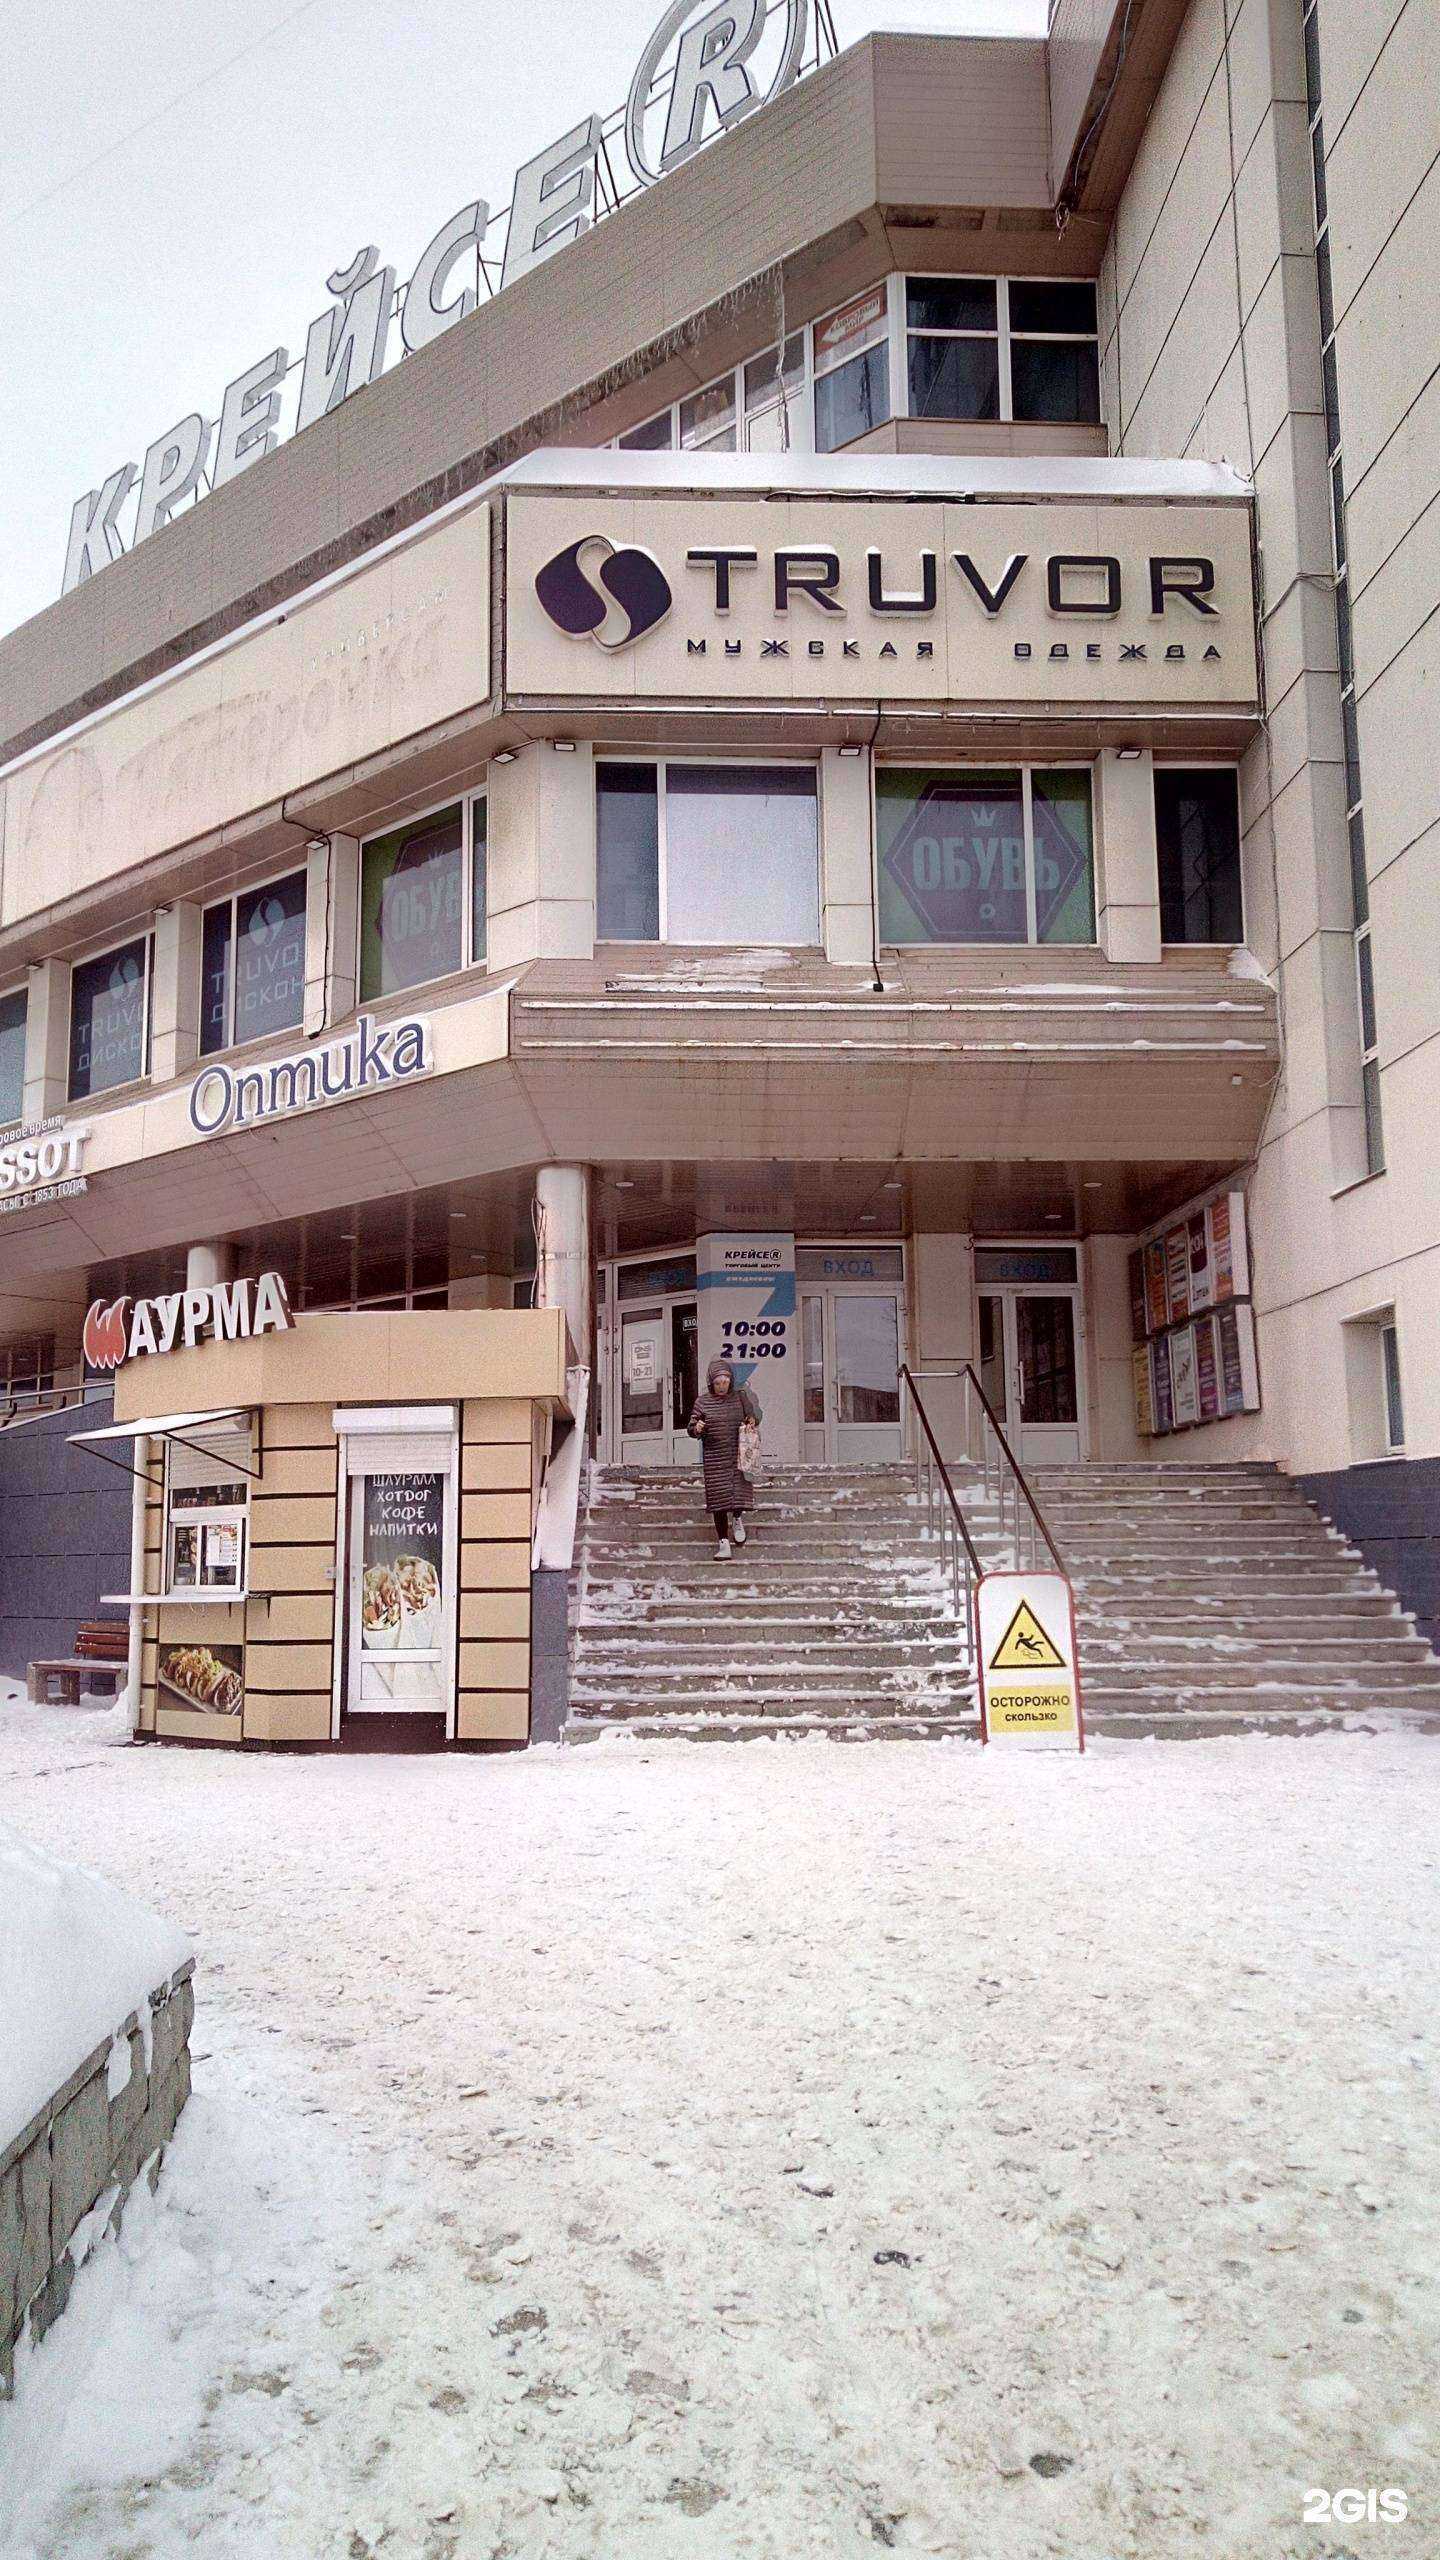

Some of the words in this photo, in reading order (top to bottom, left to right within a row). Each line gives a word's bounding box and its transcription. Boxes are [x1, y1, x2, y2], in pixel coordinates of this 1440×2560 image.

[686, 546, 1222, 618] TRUVOR
[687, 639, 934, 660] МУЖСКАЯ
[1014, 642, 1222, 662] ОДЕЖДА
[912, 836, 1061, 891] ОБУВЬ
[188, 1015, 428, 1133] Оптика
[30, 1115, 62, 1137] время
[824, 1260, 875, 1276] ВХОД
[722, 1321, 786, 1337] 10:00
[720, 1343, 787, 1358] 21:00
[382, 1505, 426, 1521] КОФЕ
[369, 1522, 438, 1536] НАПИТКИ
[990, 1695, 1070, 1708] ОСТОРОЖНО
